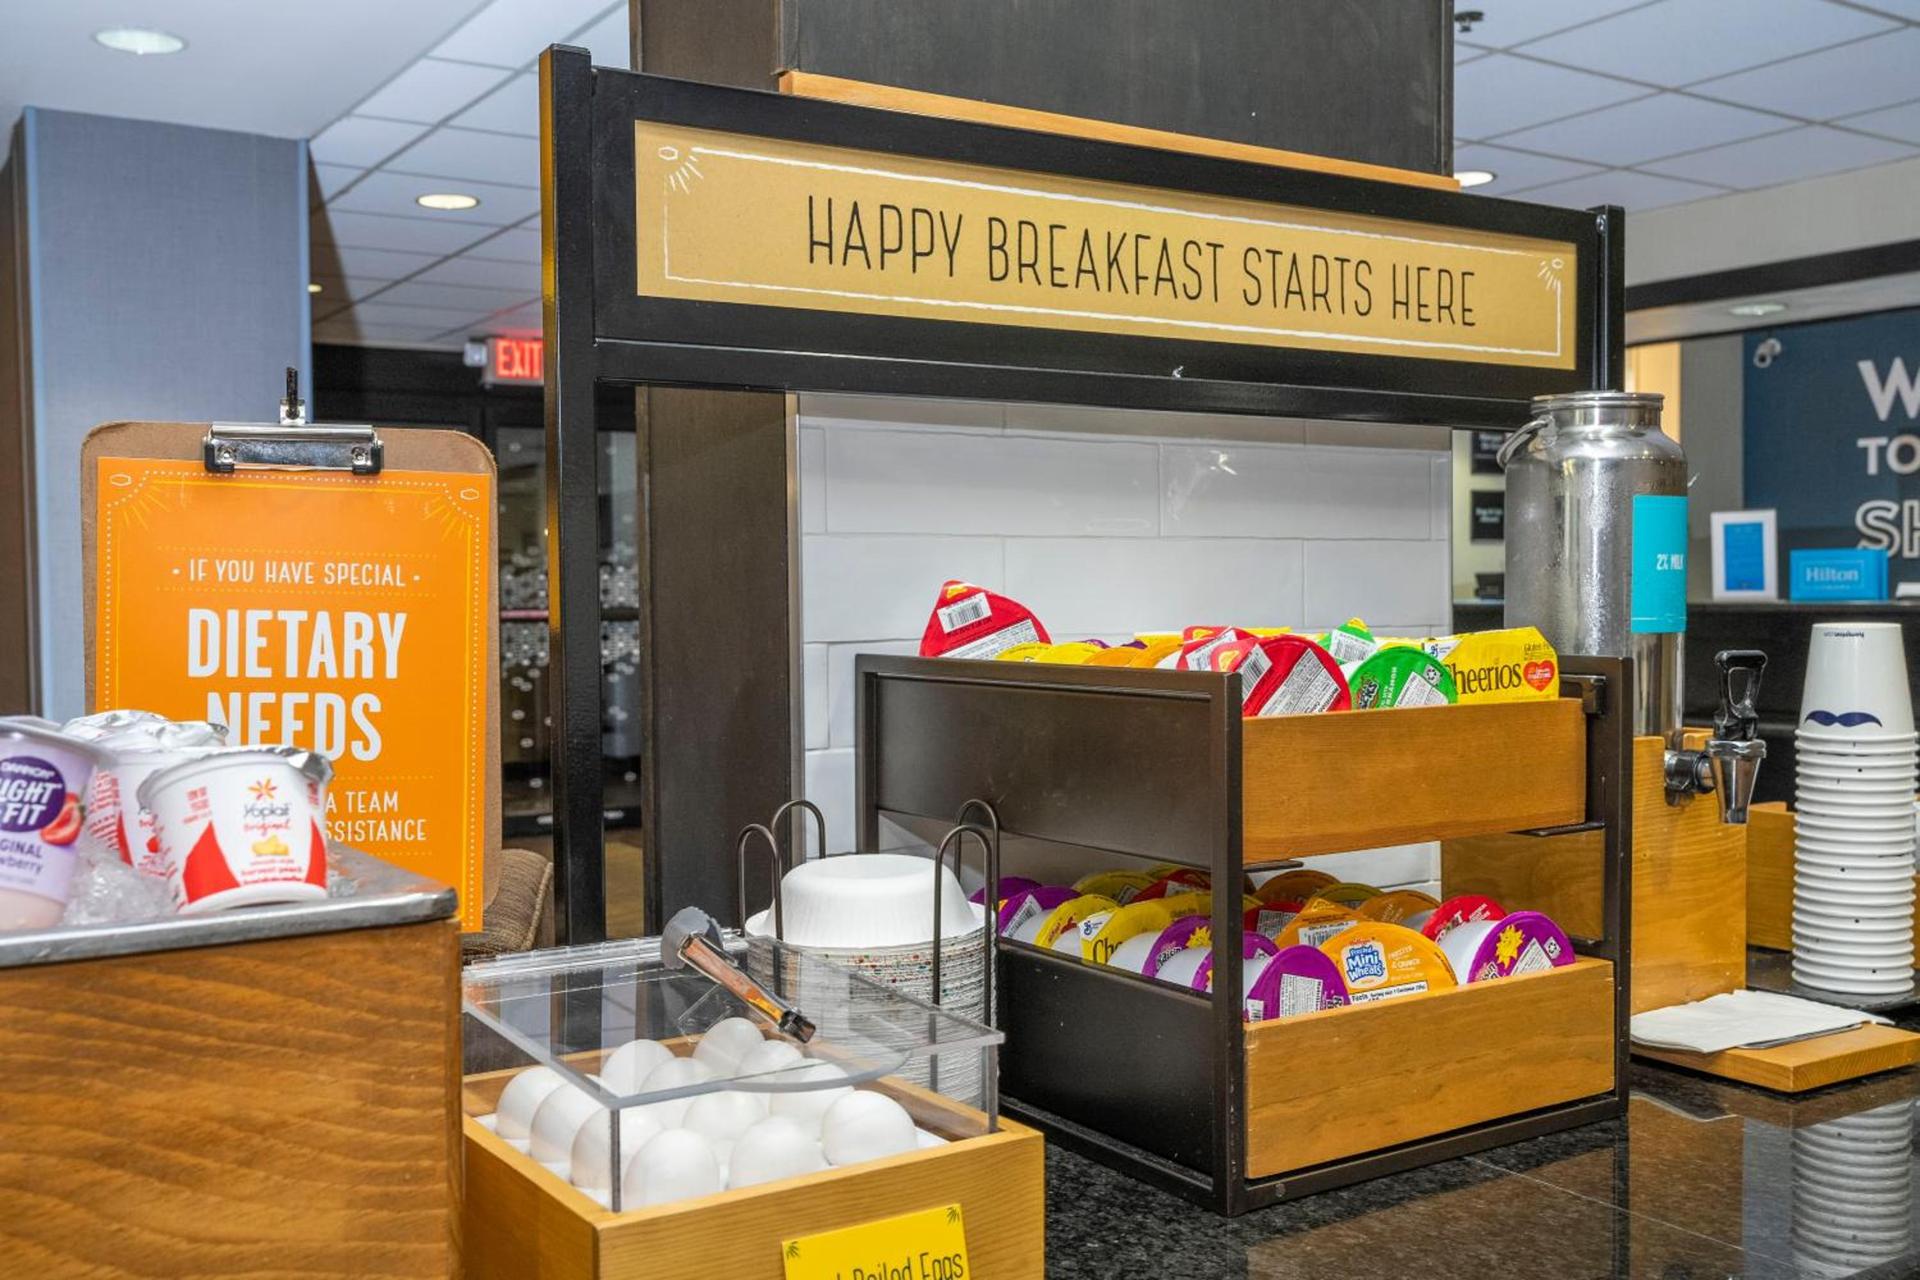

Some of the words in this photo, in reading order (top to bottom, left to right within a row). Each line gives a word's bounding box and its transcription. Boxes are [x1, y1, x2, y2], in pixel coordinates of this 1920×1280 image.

[808, 195, 963, 278] HAPPY
[988, 216, 1225, 303] BREAKFAST
[1242, 246, 1373, 317] STARTS
[1391, 263, 1476, 328] HERE
[497, 340, 543, 378] EXIT
[189, 558, 208, 582] IF
[215, 559, 255, 583] YOU
[265, 561, 315, 585] HAVE
[324, 563, 406, 587] SPECIAL
[1805, 567, 1860, 582] Hilton
[187, 608, 408, 679] DIETARY
[1445, 659, 1523, 695] heerios
[206, 691, 383, 763] NEEDS
[3, 803, 47, 826] FIT
[326, 792, 338, 814] A
[346, 790, 399, 814] TEAM
[325, 818, 427, 842] SSISTANCE
[1347, 952, 1378, 971] Mini
[1348, 962, 1384, 982] Wheats
[919, 1252, 964, 1280] Eggs
